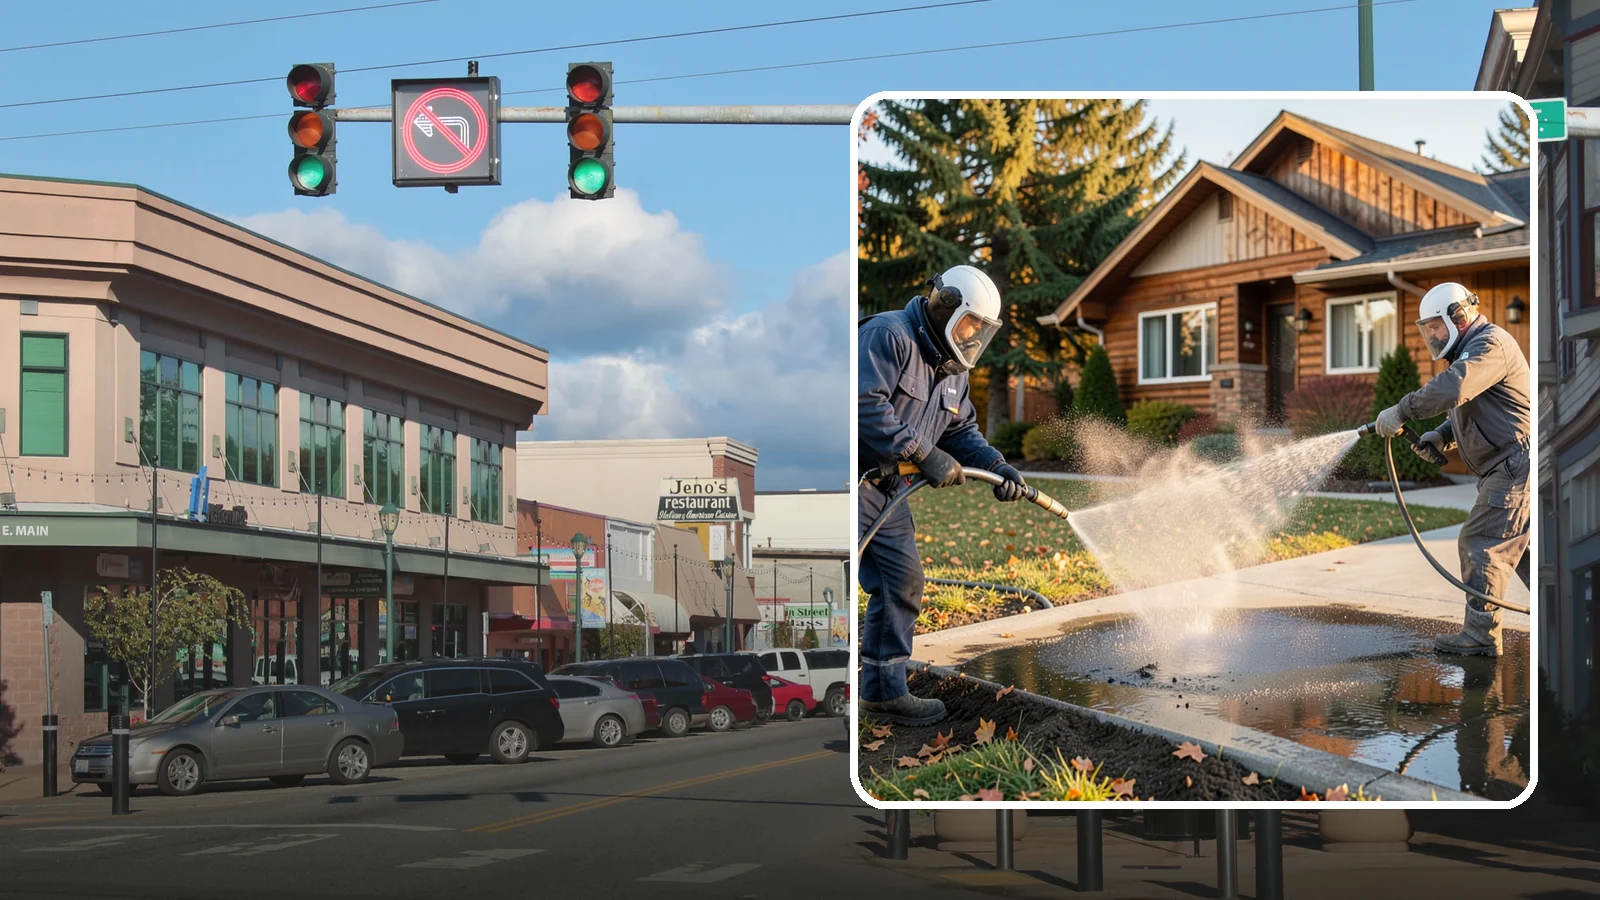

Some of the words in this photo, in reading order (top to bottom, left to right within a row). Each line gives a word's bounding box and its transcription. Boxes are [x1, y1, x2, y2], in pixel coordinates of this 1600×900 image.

[670, 480, 727, 494] Jeno's
[665, 496, 731, 509] restaurant
[658, 510, 682, 519] Italian
[686, 509, 715, 519] American
[715, 509, 738, 519] Cuisine
[2, 525, 13, 536] E.
[15, 525, 49, 536] MAIN
[797, 608, 828, 616] Street
